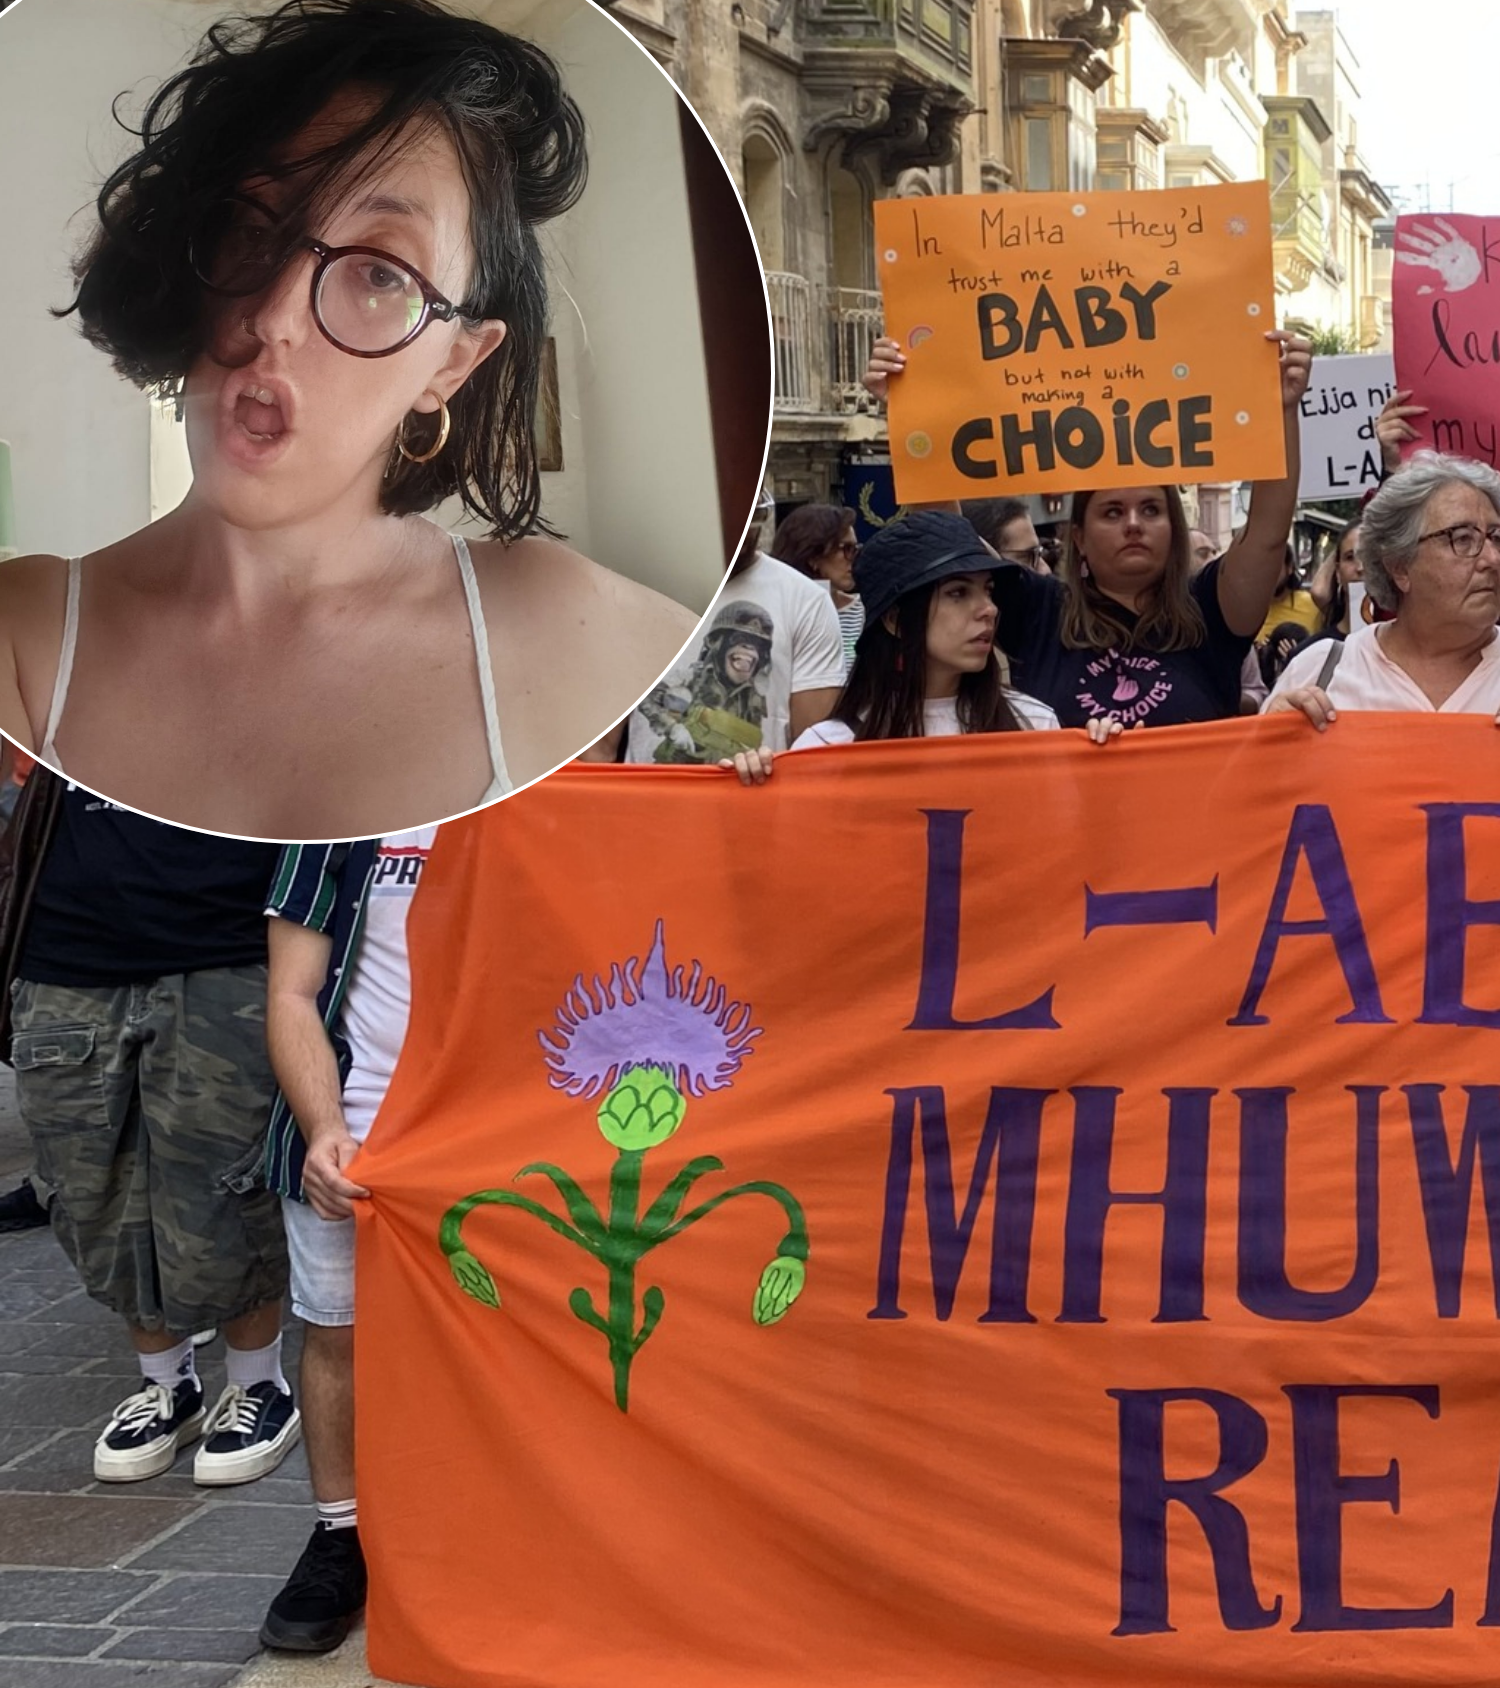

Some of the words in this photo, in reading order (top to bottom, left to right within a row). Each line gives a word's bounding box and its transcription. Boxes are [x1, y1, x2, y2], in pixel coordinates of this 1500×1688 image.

[913, 208, 942, 258] In
[981, 208, 1064, 249] Malta
[1108, 204, 1204, 248] they'd
[947, 267, 1002, 293] trust
[1020, 268, 1053, 283] me
[1080, 259, 1135, 283] with
[1165, 260, 1182, 277] a
[977, 280, 1174, 361] BABY
[1004, 367, 1045, 386] but
[1061, 364, 1093, 381] not
[1104, 364, 1145, 380] with
[1021, 388, 1086, 407] making
[1100, 384, 1115, 400] a
[1300, 386, 1357, 418] Ejja
[1432, 418, 1497, 467] my
[1086, 655, 1112, 677] MY
[1075, 692, 1107, 716] MY
[1107, 681, 1173, 723] CHOICE
